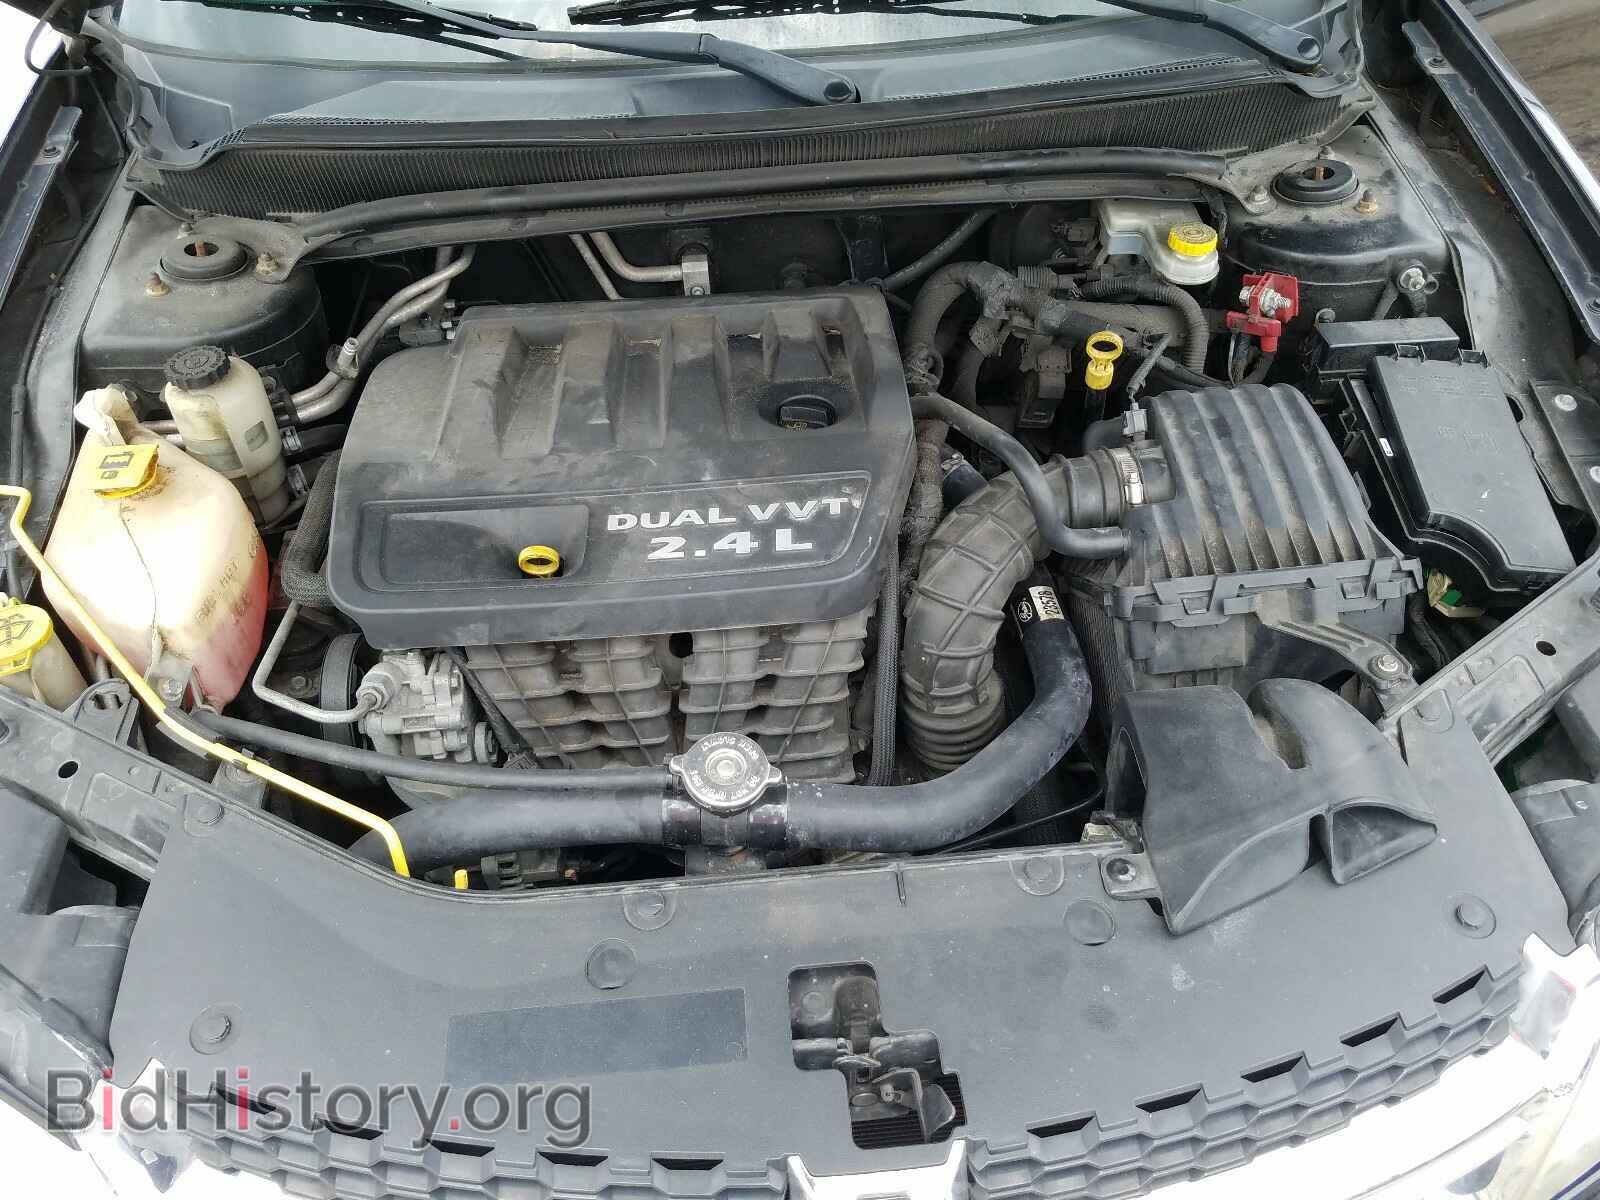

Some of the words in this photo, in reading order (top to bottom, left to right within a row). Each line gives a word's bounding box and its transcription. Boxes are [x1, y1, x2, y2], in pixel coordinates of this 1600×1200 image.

[607, 507, 737, 531] DUAL
[748, 497, 849, 521] VVT
[647, 531, 759, 560] 2.4
[775, 528, 813, 552] L
